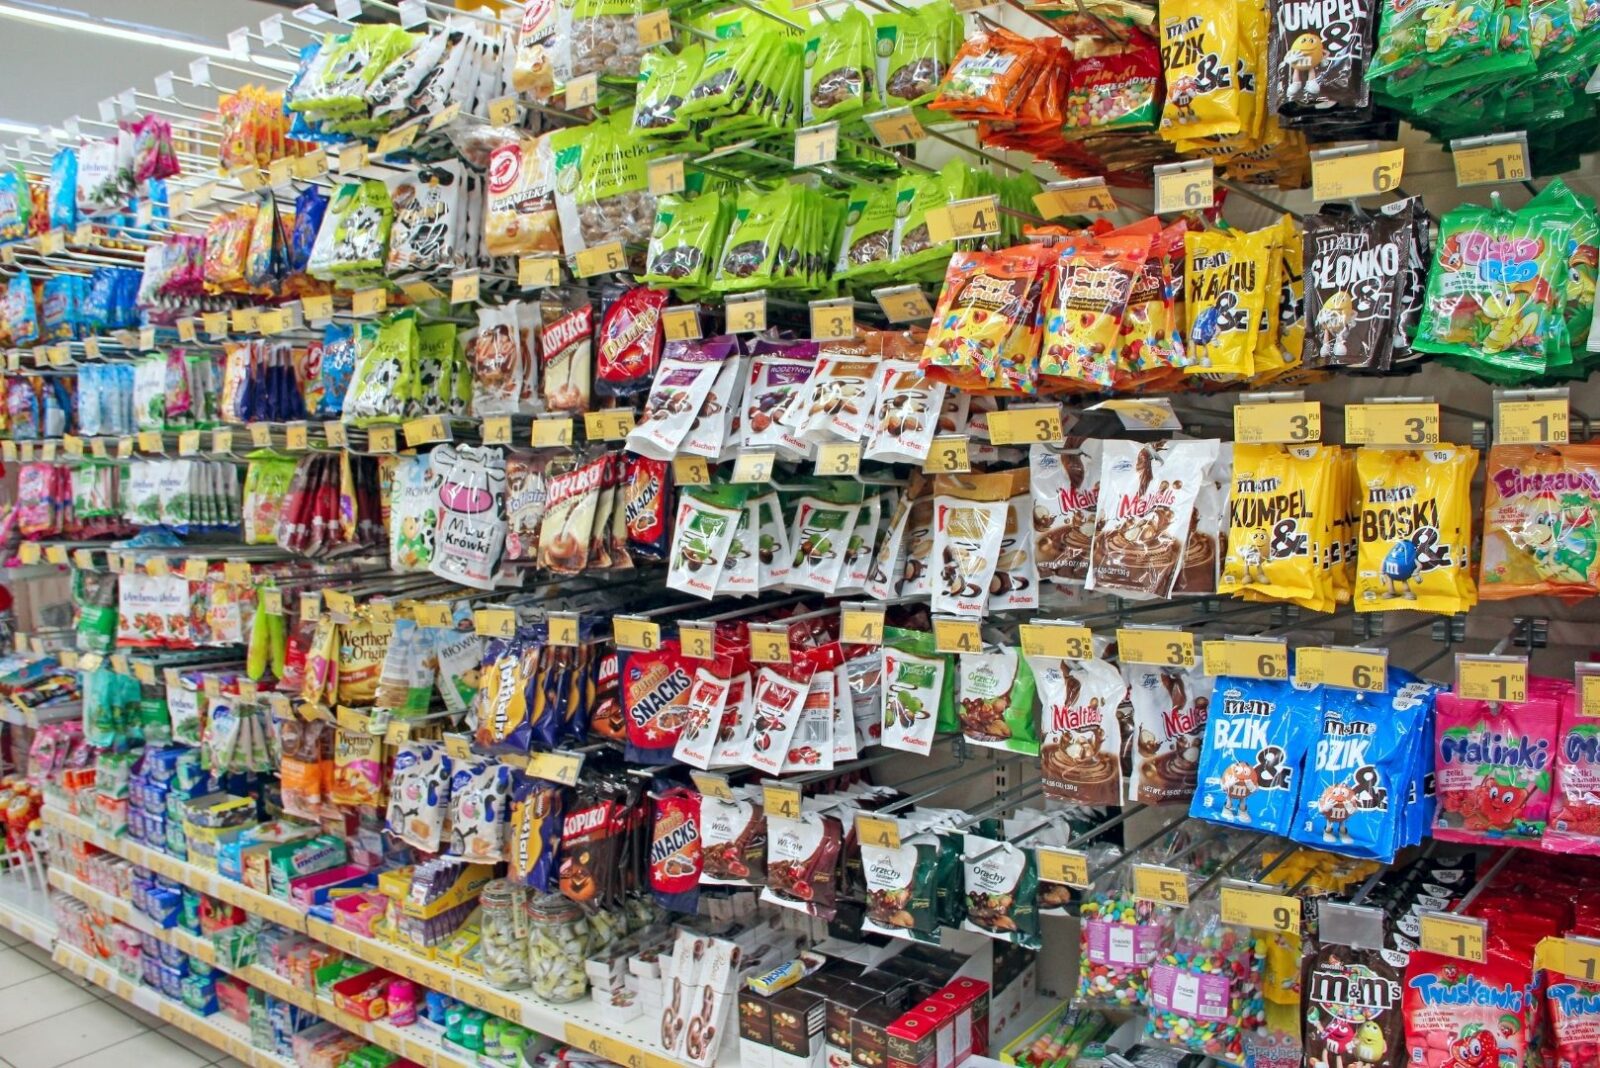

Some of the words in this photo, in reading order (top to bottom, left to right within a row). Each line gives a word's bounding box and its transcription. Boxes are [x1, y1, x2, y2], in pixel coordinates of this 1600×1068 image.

[1508, 153, 1522, 163] PLN
[1372, 165, 1391, 192] 6
[1487, 158, 1505, 180] 1
[1510, 168, 1524, 178] 09
[1184, 182, 1200, 206] 6
[972, 211, 986, 233] 4
[607, 252, 617, 270] 5
[1311, 243, 1400, 289] SŁONKO
[744, 312, 756, 330] 3
[831, 317, 843, 337] 3
[1290, 415, 1308, 440] 3
[1309, 431, 1320, 440] 98
[1425, 415, 1438, 423] PLN
[618, 421, 628, 437] 5
[1035, 420, 1049, 441] 3
[1404, 418, 1425, 443] 3
[1532, 418, 1548, 441] 1
[1553, 431, 1567, 441] 09
[782, 433, 806, 450] Auchan
[1425, 434, 1438, 444] 98
[836, 453, 849, 473] 3
[943, 450, 958, 471] 3
[1433, 451, 1448, 462] 90g
[689, 466, 700, 481] 3
[751, 463, 762, 481] 3
[1229, 489, 1313, 528] KUMPEL
[1362, 498, 1440, 543] BOSKI
[445, 533, 491, 554] Krówki
[687, 579, 712, 591] Auchan
[561, 628, 569, 643] 4
[642, 631, 652, 648] 6
[861, 623, 874, 640] 4
[694, 638, 704, 656] 3
[957, 633, 970, 651] 4
[1066, 638, 1082, 658] 3
[1082, 650, 1093, 660] 99
[769, 643, 780, 661] 3
[1166, 643, 1182, 664] 3
[1183, 656, 1194, 666] 99
[1257, 655, 1275, 677] 6
[1275, 668, 1287, 678] 28
[1372, 665, 1384, 673] PLN
[1352, 665, 1371, 689] 6
[1371, 680, 1383, 691] 28
[1511, 675, 1524, 683] PLN
[1490, 675, 1506, 700] 1
[1512, 691, 1524, 701] 19
[630, 668, 693, 728] SNACKS
[903, 736, 928, 747] Auchan
[1214, 718, 1270, 750] BZIK
[1315, 738, 1371, 771] BZIK
[1440, 731, 1550, 770] Malinki
[556, 765, 568, 780] 4
[780, 800, 791, 818] 4
[880, 831, 890, 848] 4
[973, 866, 1006, 884] Orzechy
[1062, 864, 1077, 884] 5
[1160, 881, 1176, 902] 5
[1273, 907, 1290, 930] 9
[1450, 934, 1466, 955] 1
[1469, 935, 1481, 943] PLN
[1387, 951, 1406, 965] 250g
[1470, 951, 1481, 960] 19
[1578, 957, 1596, 979] 1
[1409, 973, 1522, 1012] Truskawki
